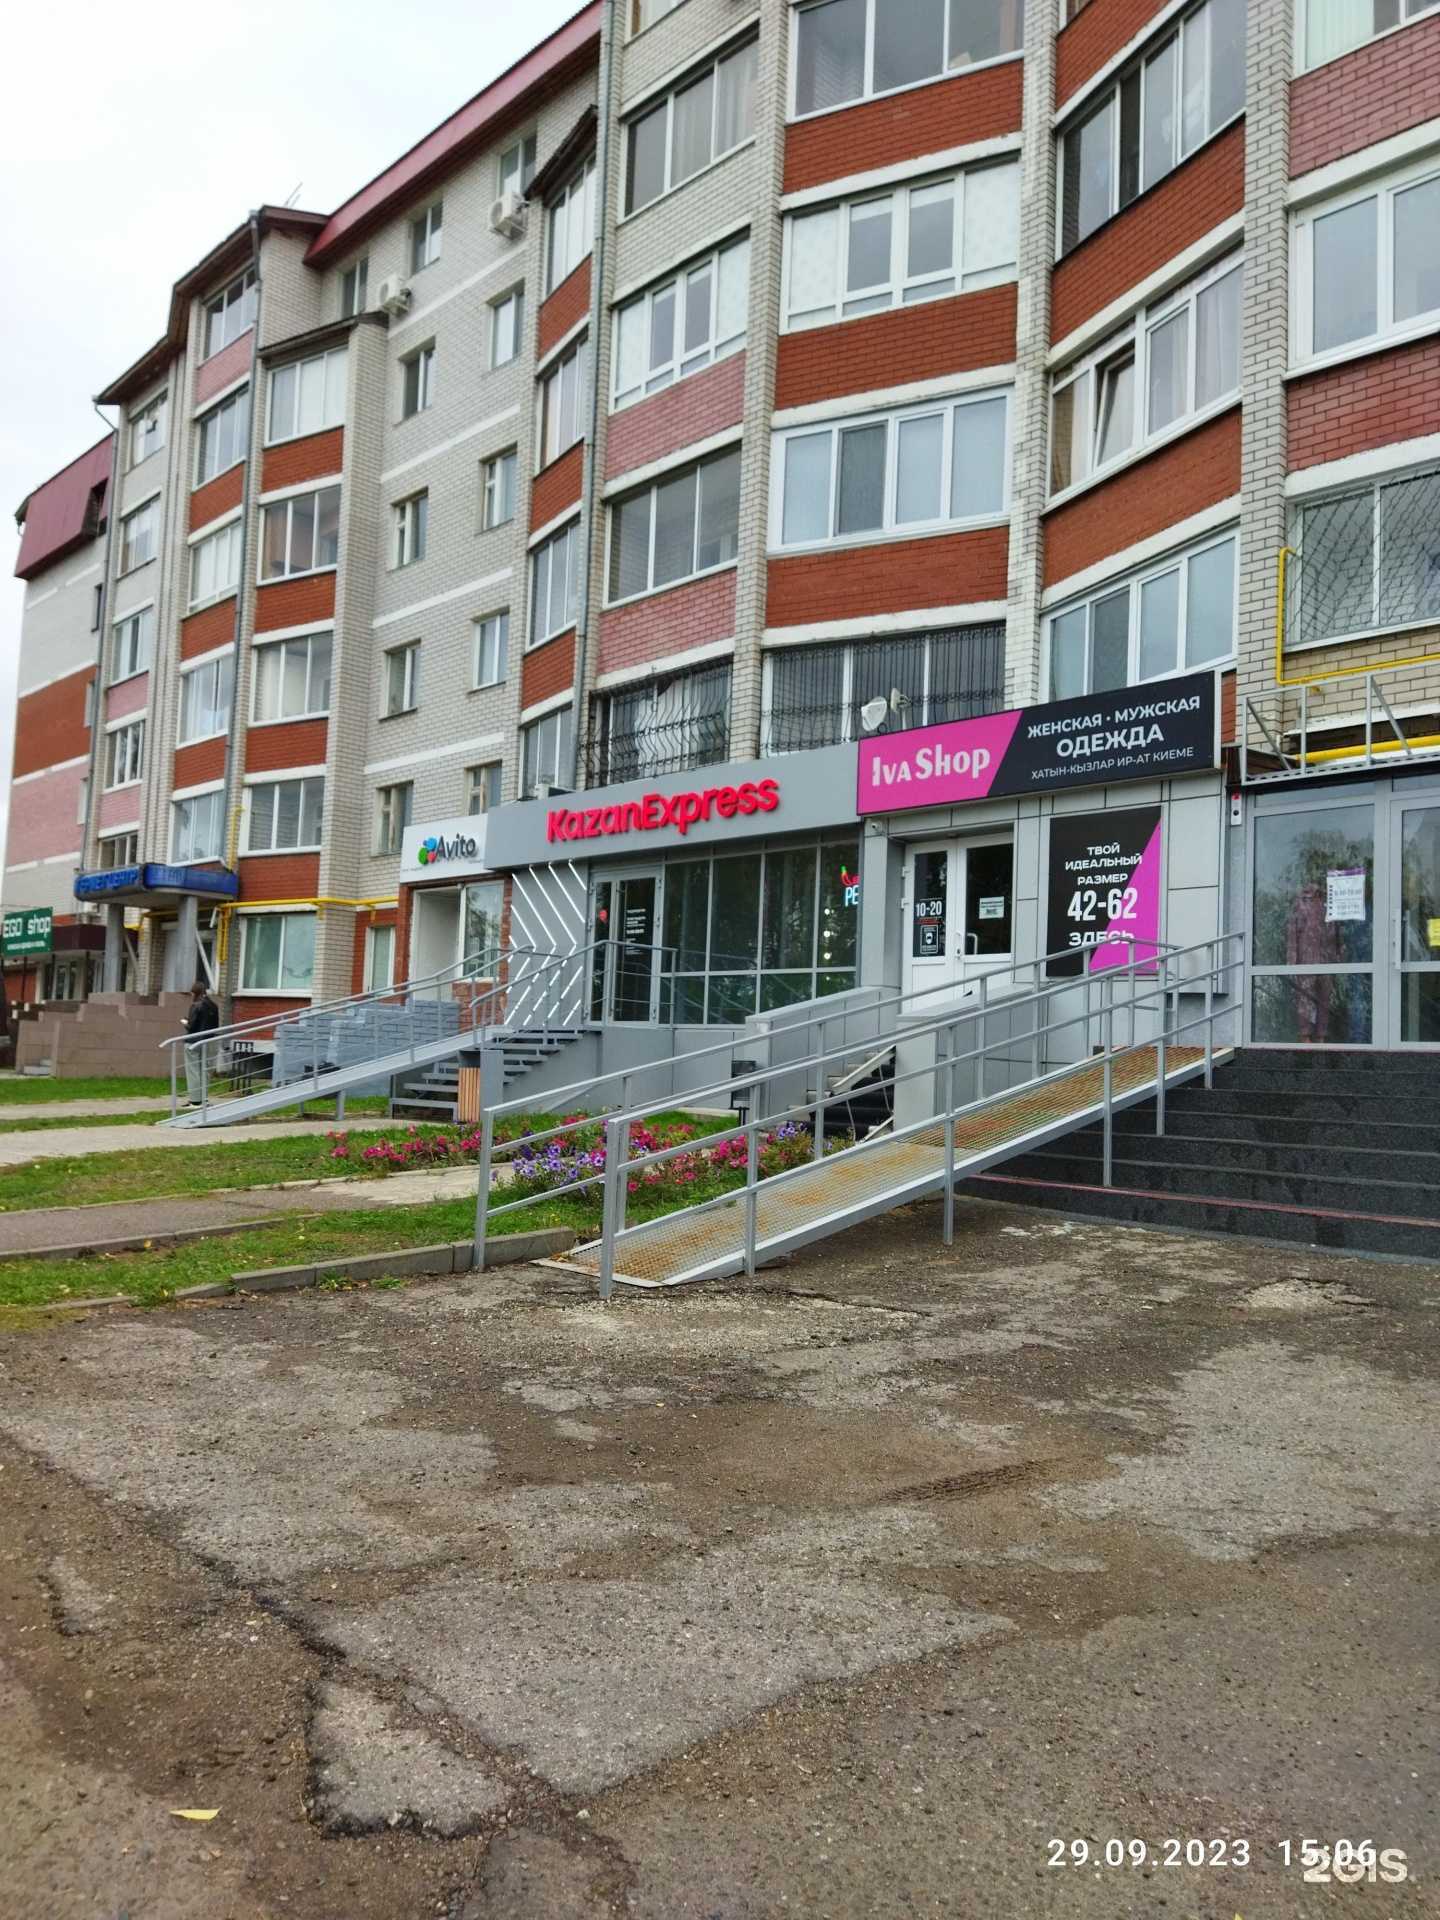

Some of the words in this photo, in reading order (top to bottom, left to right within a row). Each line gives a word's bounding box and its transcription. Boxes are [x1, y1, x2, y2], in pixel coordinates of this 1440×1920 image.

[1027, 713, 1102, 739] ЖЕНСКАЯ
[1114, 695, 1200, 724] МУЖСКАЯ
[1056, 723, 1165, 759] ОДЕЖДА
[915, 743, 991, 780] Shop
[1031, 758, 1116, 780] ХАТЫН-КЫЗЛАР
[1116, 753, 1151, 768] ИР-АТ
[1153, 746, 1194, 762] КИЕМЕ
[546, 779, 779, 843] KazanExpress
[436, 832, 477, 859] Avito
[1065, 853, 1142, 871] ИДЕАЛЬНЫЙ
[1087, 842, 1120, 856] ТВОЙ
[1077, 873, 1128, 885] РАЗМЕР
[915, 900, 943, 917] 10-20
[1067, 887, 1138, 921] 42-62
